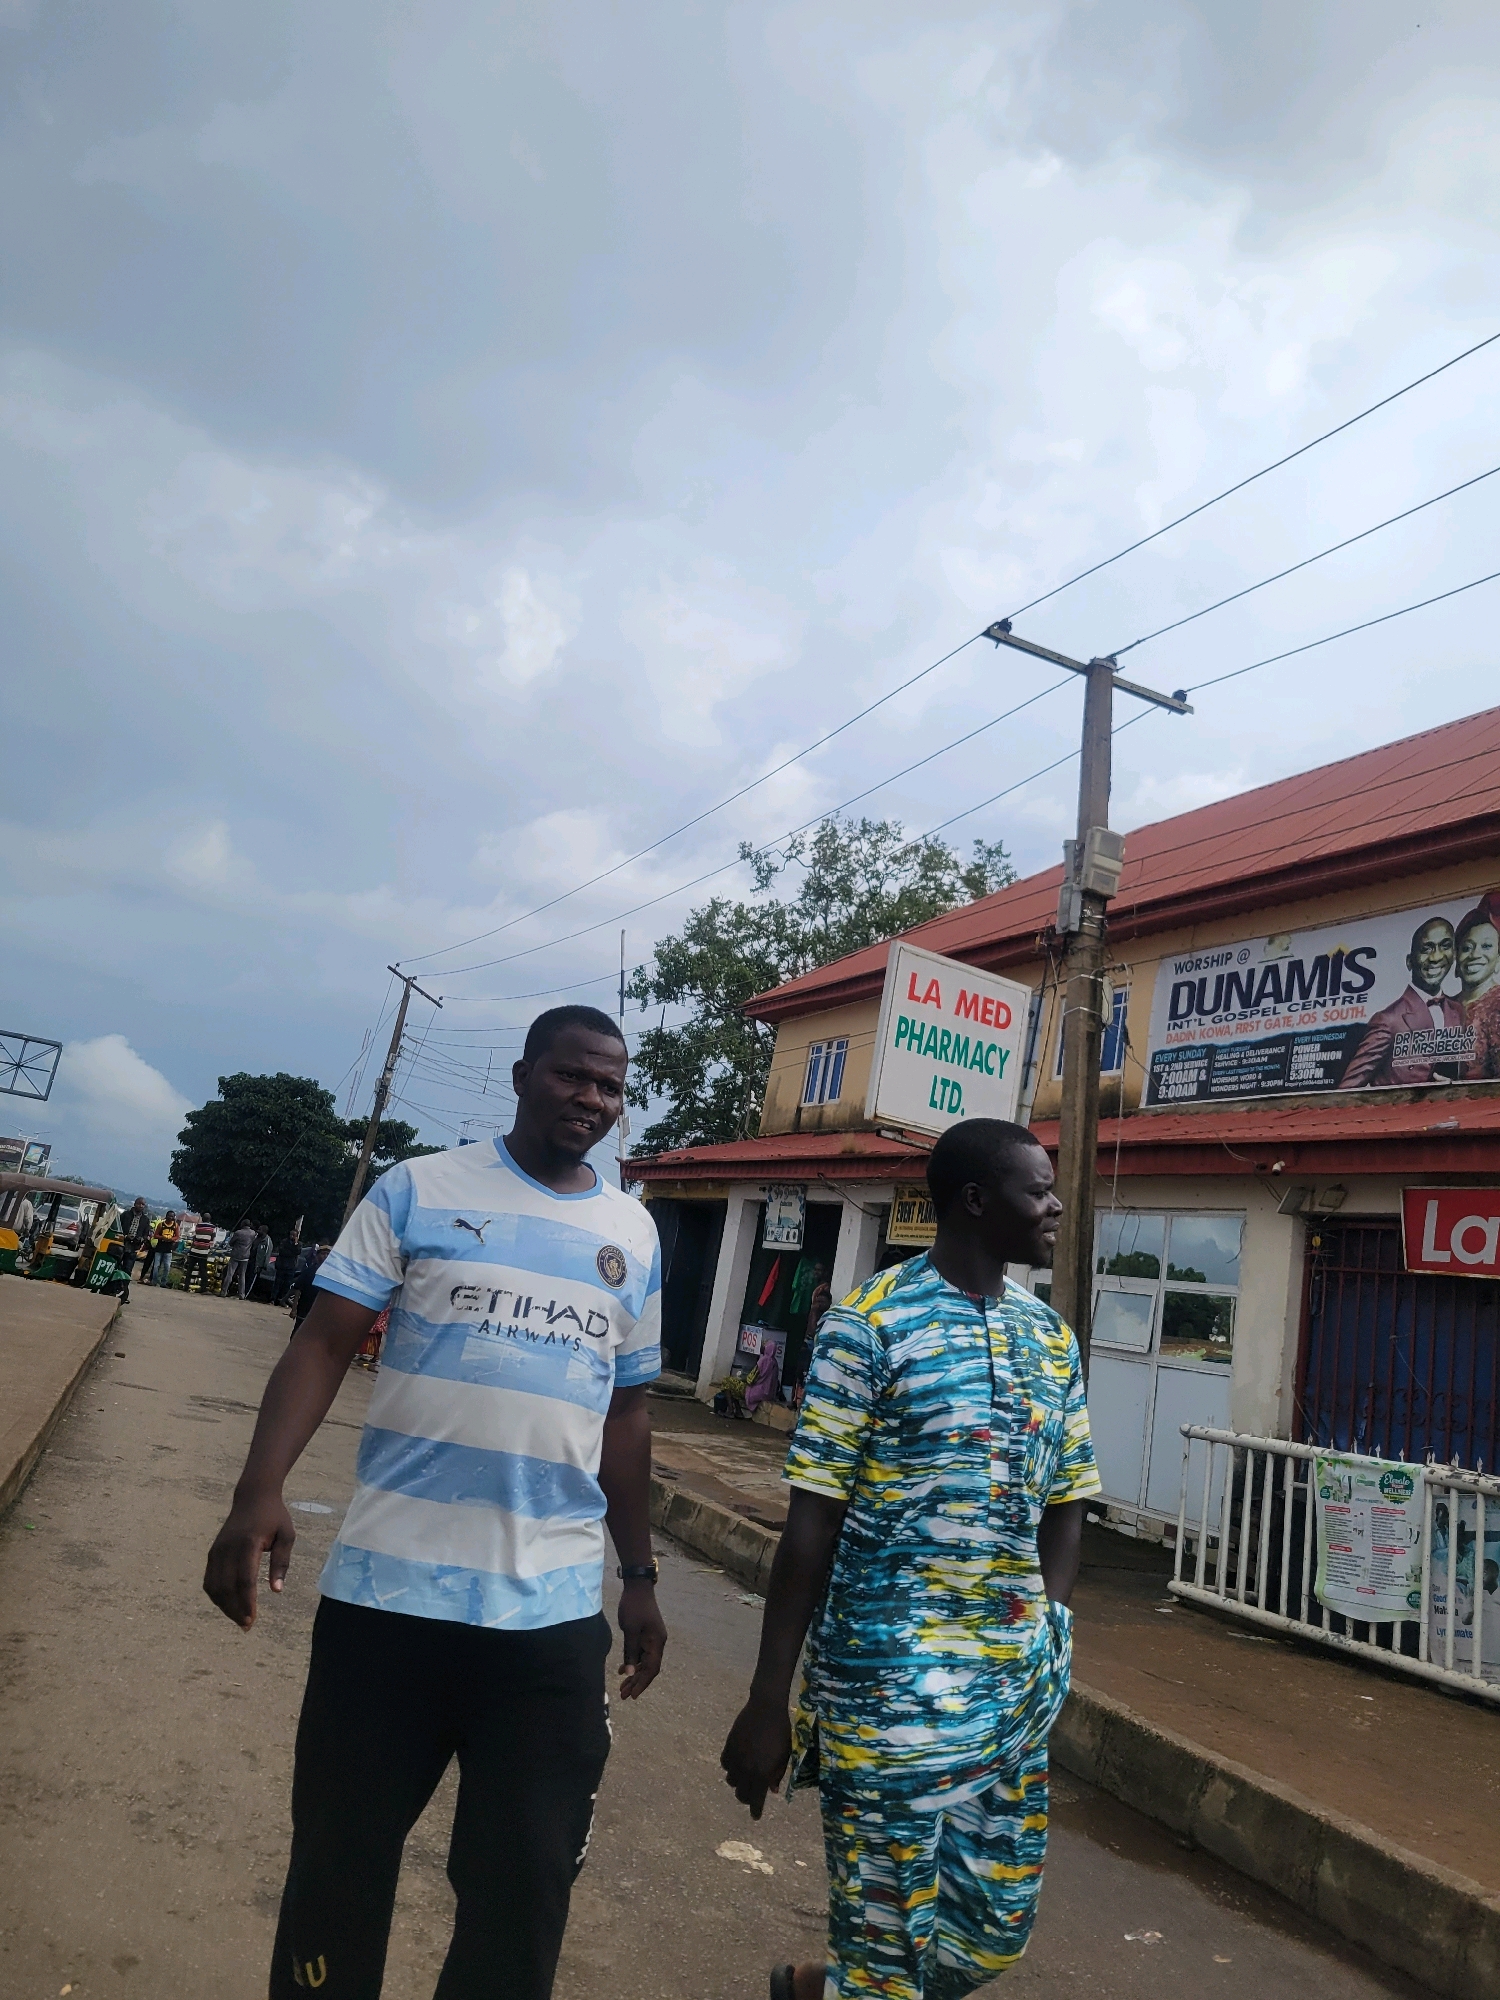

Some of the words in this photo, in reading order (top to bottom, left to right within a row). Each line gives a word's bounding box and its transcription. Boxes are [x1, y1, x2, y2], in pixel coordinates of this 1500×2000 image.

[1174, 951, 1233, 975] WORSHIP
[1237, 949, 1250, 965] @
[1168, 947, 1377, 1021] DUNAMIS
[907, 972, 942, 1010] LA
[954, 989, 1012, 1030] MED
[1167, 1018, 1205, 1031] INT'L
[1211, 1007, 1281, 1025] GOSPEL
[1287, 993, 1368, 1012] CENTRE
[1166, 1030, 1196, 1044] DADIN
[1200, 1024, 1233, 1039] KOWA,
[1235, 1020, 1261, 1035] FIRST
[1264, 1016, 1294, 1030] GATE,
[1295, 1012, 1317, 1026] JOS
[1323, 1006, 1367, 1022] SOUTH.
[1294, 1036, 1311, 1044] EVERY
[1312, 1032, 1347, 1042] WEDNESDAY
[1395, 1032, 1411, 1044] DR
[1413, 1030, 1434, 1043] PST
[1435, 1026, 1464, 1040] PAUL
[1466, 1025, 1475, 1037] &
[894, 1015, 1010, 1079] PHARMACY
[1155, 1053, 1177, 1062] EVERY
[1178, 1048, 1207, 1060] SUNDAY
[1215, 1052, 1240, 1060] HEALING
[1245, 1046, 1286, 1057] DELIVERANCE
[1293, 1043, 1320, 1054] POWER
[1393, 1045, 1408, 1057] DR
[1411, 1041, 1434, 1055] MRS
[1436, 1037, 1476, 1053] BECKY
[1214, 1060, 1238, 1068] SERVICE
[1292, 1051, 1342, 1062] COMMUNION
[1153, 1064, 1164, 1072] 1ST
[1170, 1062, 1183, 1071] 2ND
[1184, 1059, 1209, 1069] SERVICE
[1291, 1062, 1316, 1070] SERVICE
[1160, 1069, 1198, 1085] 7:00AM
[1199, 1069, 1207, 1081] &
[1290, 1068, 1324, 1080] 5:30PM
[1158, 1082, 1197, 1098] 9:00AM
[1211, 1084, 1239, 1092] WONDERS
[1240, 1082, 1257, 1090] NIGHT
[928, 1075, 965, 1116] LTD.
[1422, 1200, 1500, 1264] La
[450, 1285, 609, 1338] ETIHAD
[477, 1318, 582, 1352] AIRWAYS
[742, 1331, 758, 1347] POS
